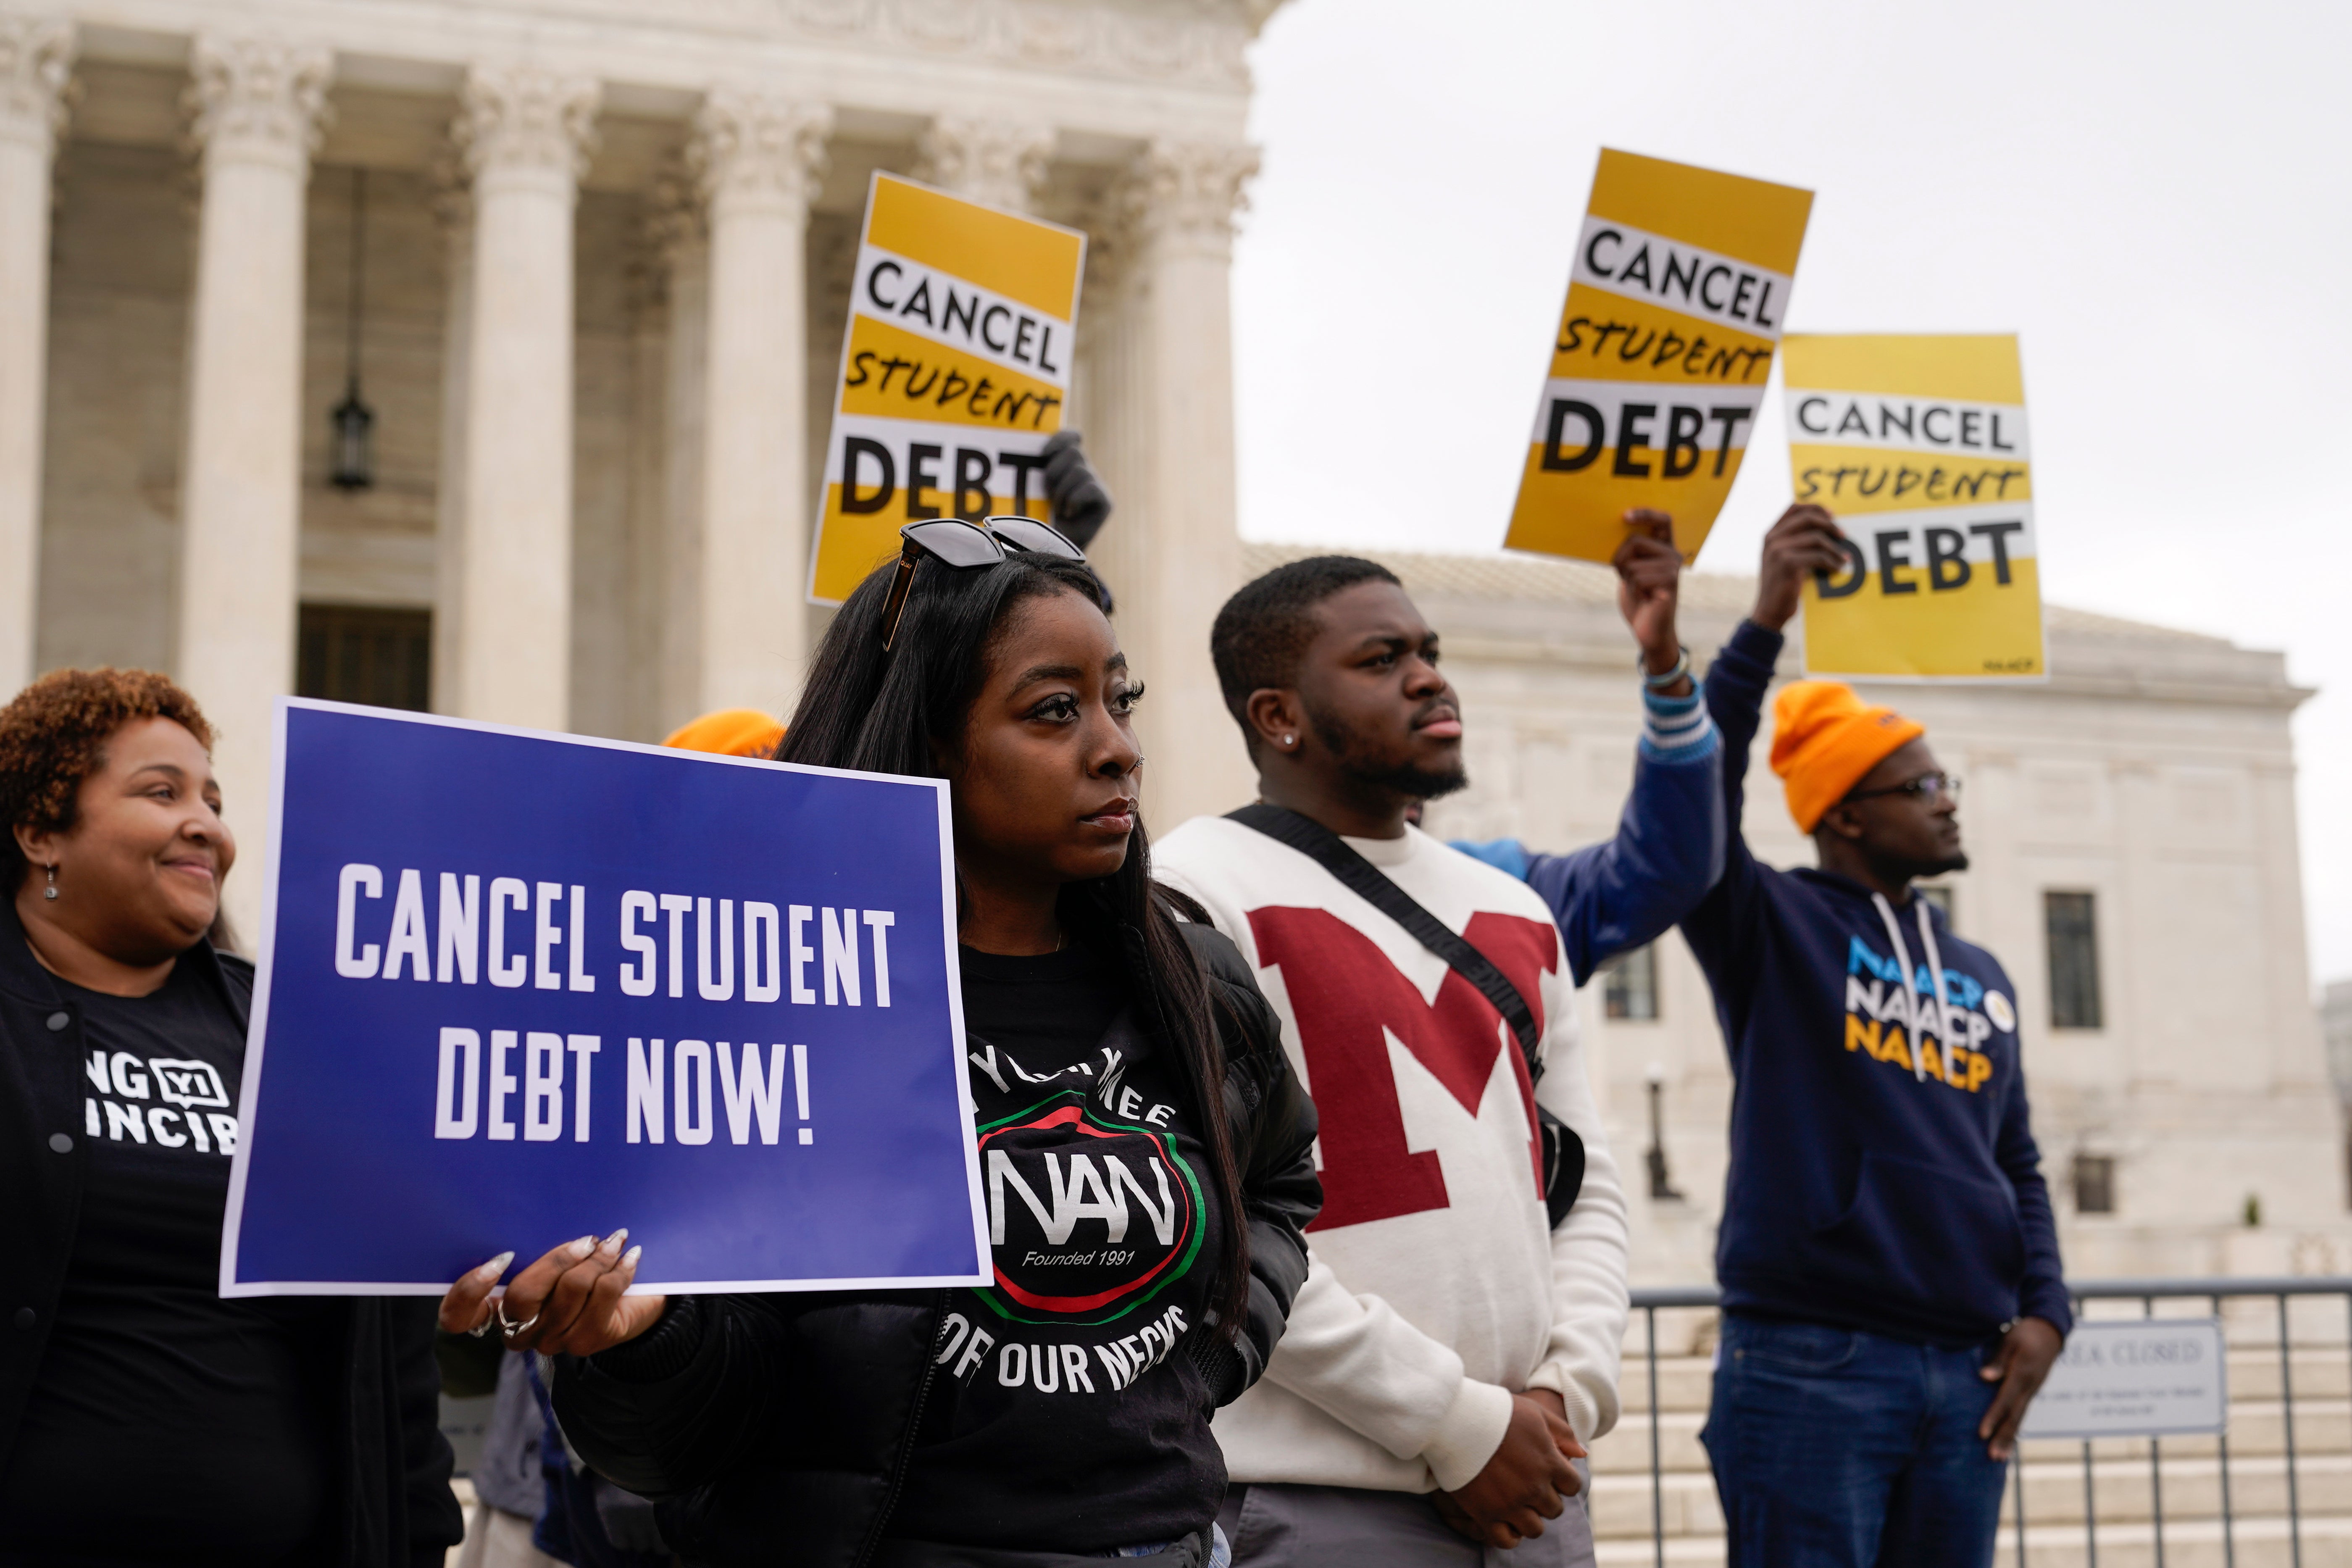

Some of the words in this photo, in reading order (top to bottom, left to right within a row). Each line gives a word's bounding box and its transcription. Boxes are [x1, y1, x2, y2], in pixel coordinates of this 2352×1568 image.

[867, 261, 1057, 375] CANCEL
[1585, 229, 1773, 330] CANCEL
[846, 351, 1060, 427] STUDENT
[1557, 317, 1771, 381] STUDENT
[1540, 398, 1753, 479] DEBT
[1797, 397, 2015, 453] CANCEL
[839, 435, 1046, 524] DEBT
[1799, 463, 2024, 500] STUDENT
[900, 560, 912, 569] QUAY
[1815, 522, 2023, 602] DEBT
[335, 863, 595, 992] CANCEL
[618, 889, 894, 1008] STUDENT
[1399, 908, 1468, 961] NIKE
[1848, 934, 1983, 1010] NAACP
[1844, 1012, 1993, 1093] NAACP
[1846, 975, 1992, 1051] NAACP
[164, 1071, 210, 1096] YI
[434, 1027, 601, 1143] DEBT
[626, 1037, 813, 1145] NOW!
[1244, 905, 1557, 1233] M
[988, 1150, 1175, 1245] NAN
[1022, 1251, 1096, 1266] Founded
[1099, 1250, 1135, 1265] 1991
[936, 1313, 995, 1387] OF
[998, 1343, 1095, 1393] OUR
